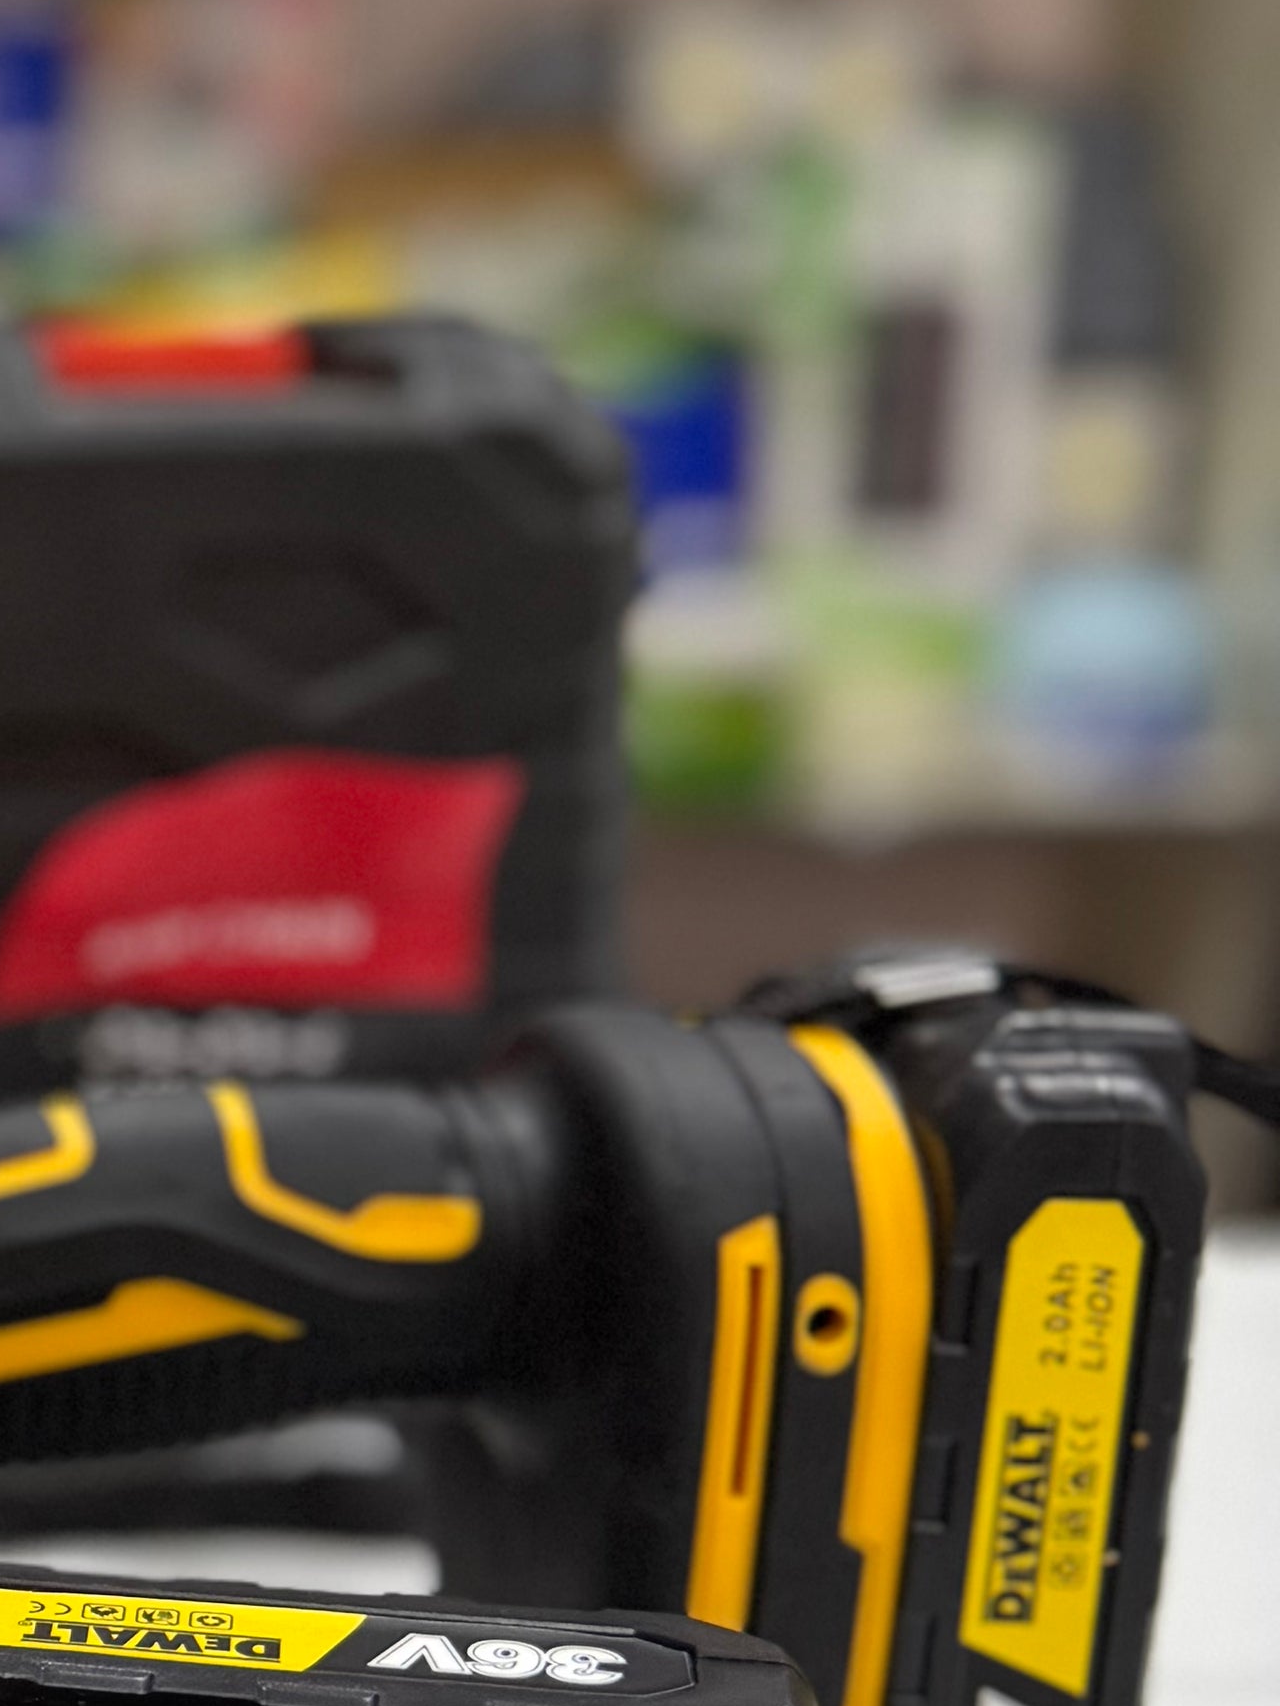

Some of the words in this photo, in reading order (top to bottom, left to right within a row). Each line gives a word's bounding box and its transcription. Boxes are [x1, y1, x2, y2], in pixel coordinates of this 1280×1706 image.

[1039, 1261, 1079, 1368] 2.0Ah
[1077, 1265, 1120, 1373] LI-ION
[985, 1412, 1058, 1623] DEWALT
[22, 1620, 281, 1663] DEWALT
[366, 1632, 628, 1686] 36V
